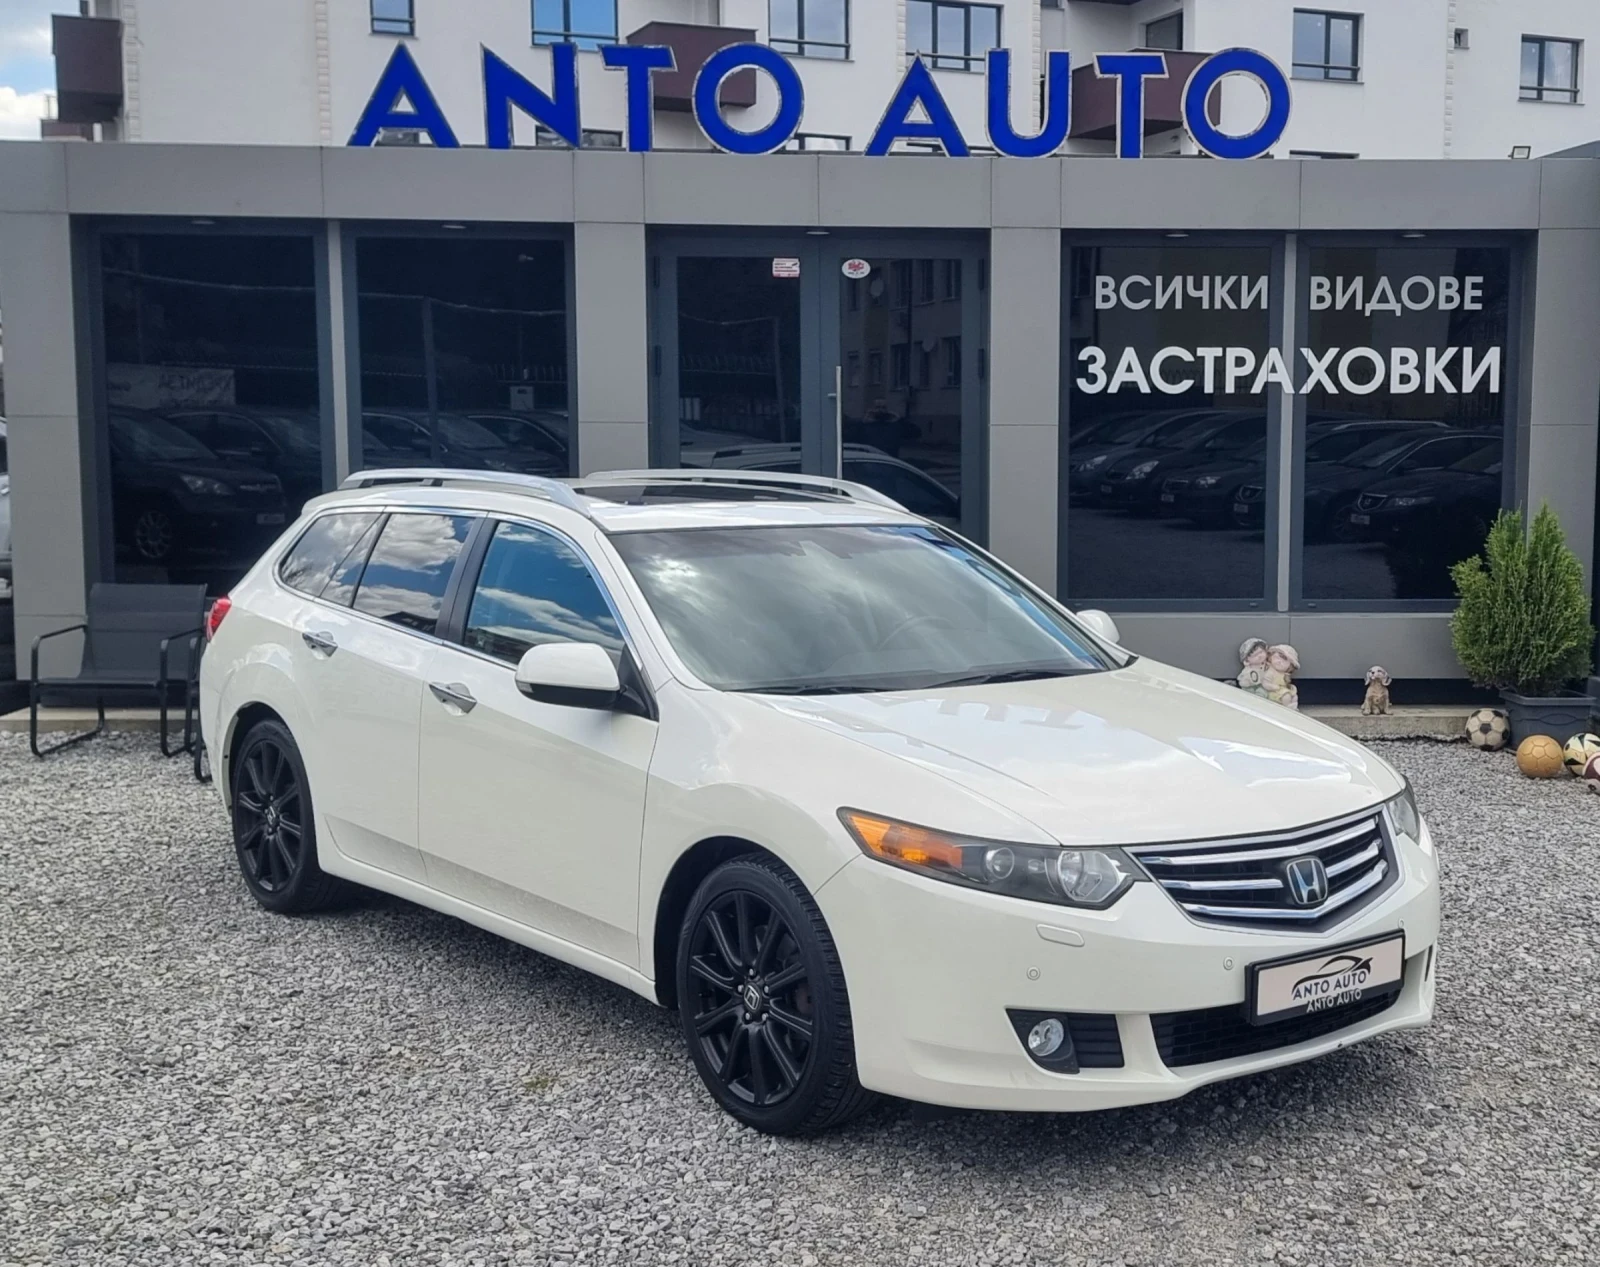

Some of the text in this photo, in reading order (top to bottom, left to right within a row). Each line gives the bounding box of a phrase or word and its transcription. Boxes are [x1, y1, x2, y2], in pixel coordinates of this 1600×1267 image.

[346, 39, 1293, 159] ANTO AUTO
[1094, 274, 1484, 317] ВСИЧКИ ВИДОВЕ
[1075, 345, 1501, 395] ЗАСТРАХОВКИ
[1293, 970, 1367, 1001] ANTO AUTO
[1306, 987, 1362, 1013] ANTO AUTO
